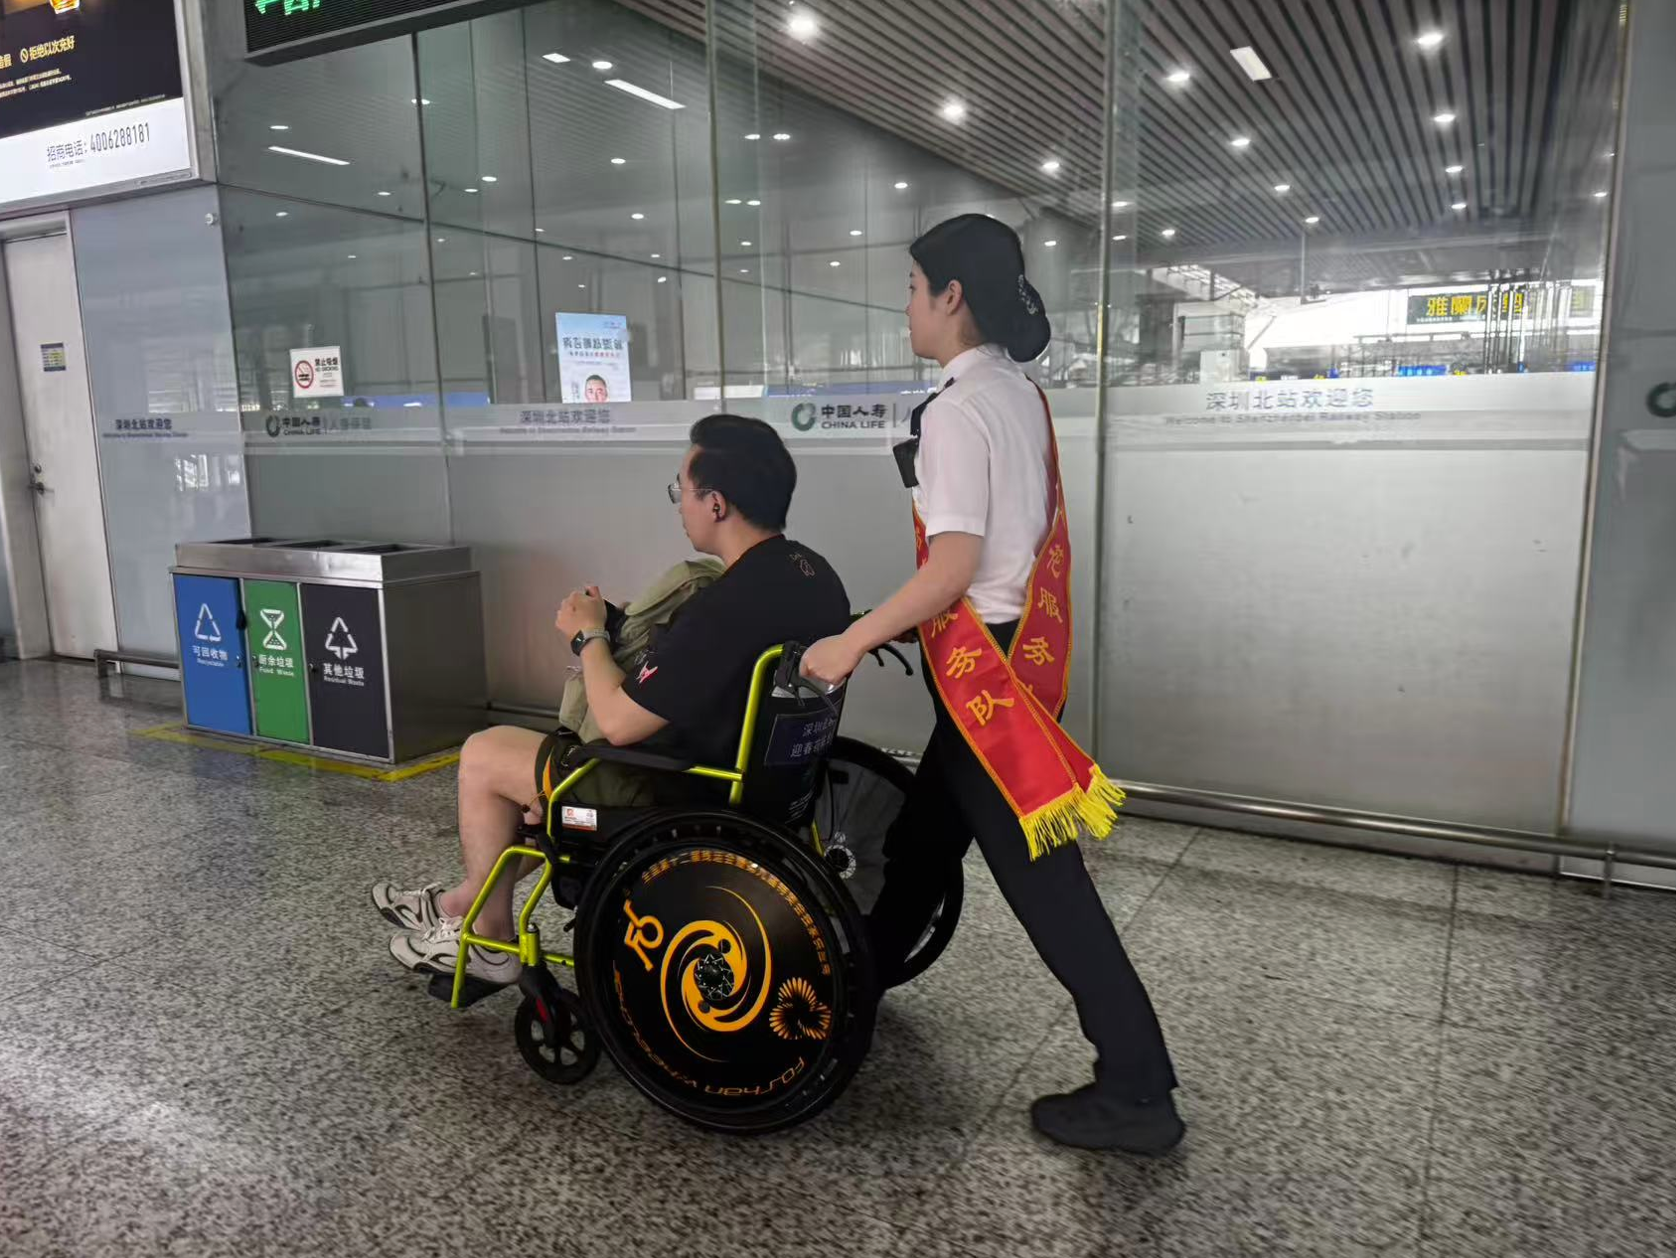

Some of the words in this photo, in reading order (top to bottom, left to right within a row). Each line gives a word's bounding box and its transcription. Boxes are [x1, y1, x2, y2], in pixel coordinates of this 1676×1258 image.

[29, 36, 75, 60] 拒绝以次充好
[1206, 388, 1373, 411] 深圳北站欢迎您
[821, 404, 888, 418] 中国人寿
[821, 421, 857, 429] CHINA
[860, 420, 885, 429] LIFE
[191, 645, 228, 661] 可回收物
[258, 654, 294, 668] 厨余垃圾
[323, 663, 365, 679] 其他垃圾
